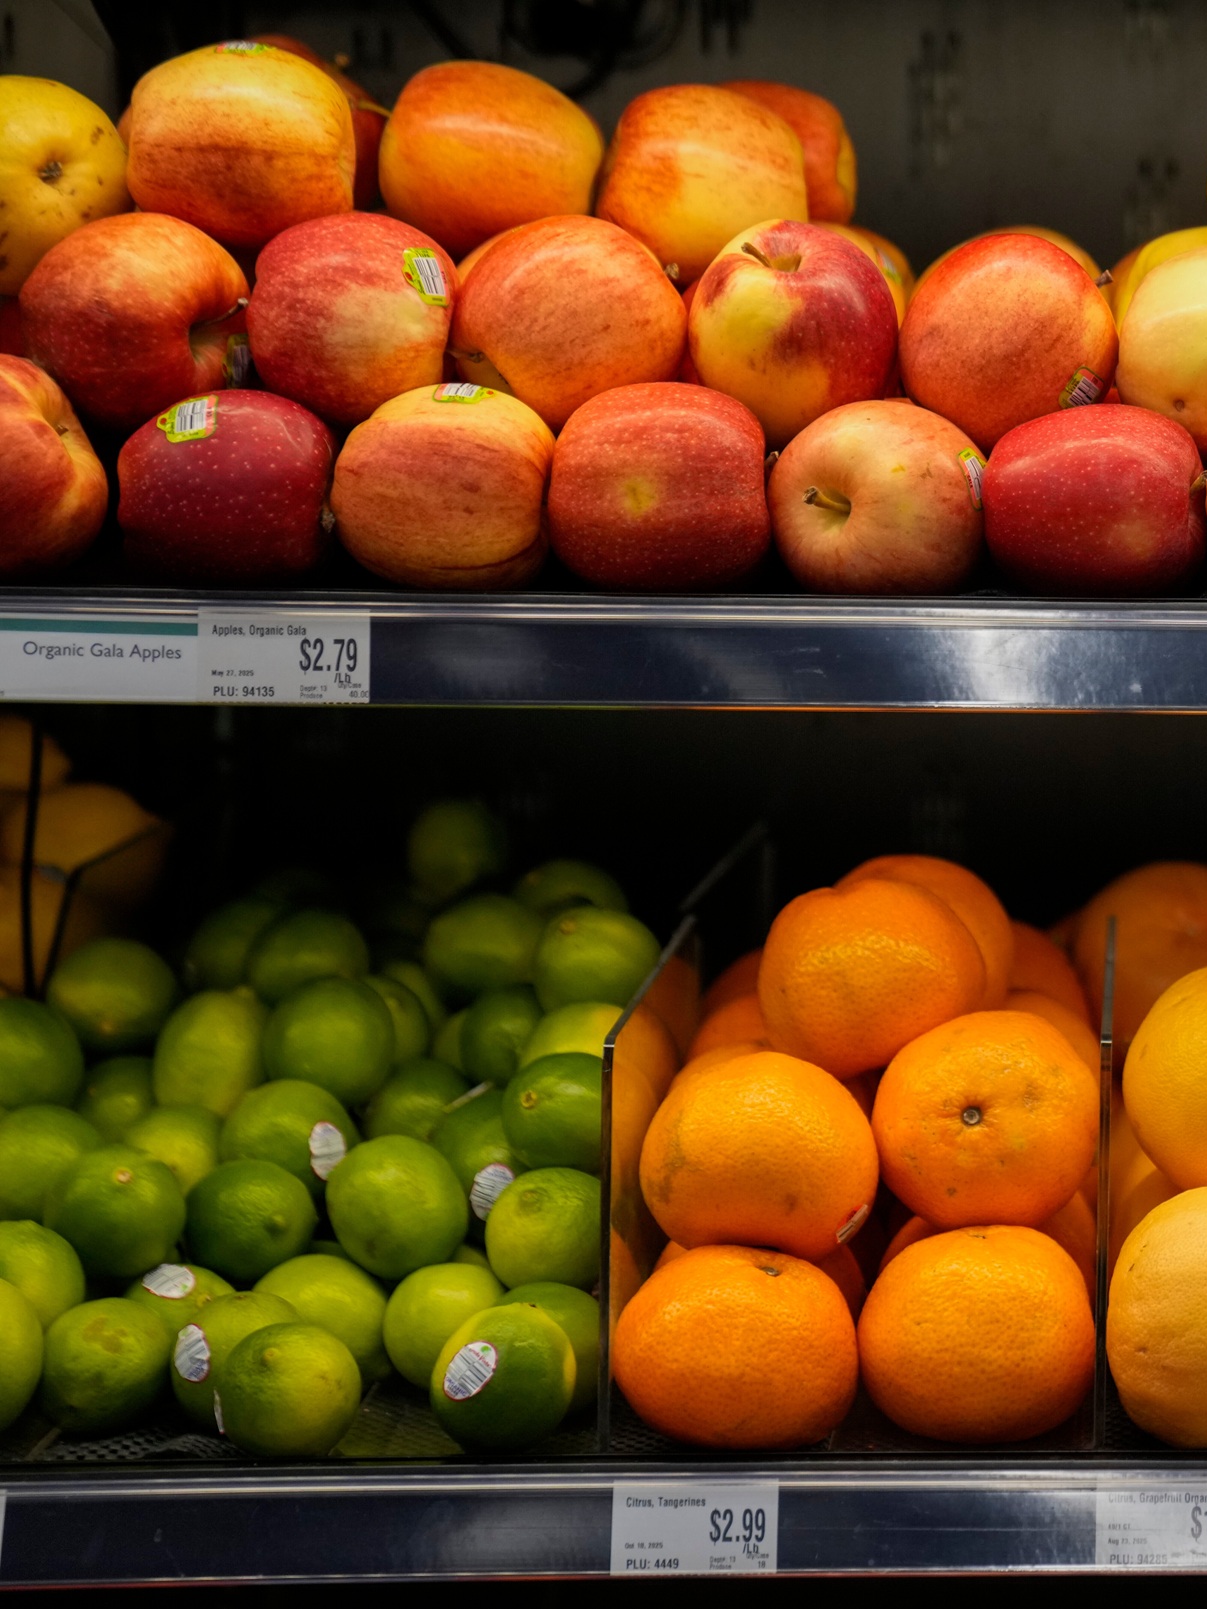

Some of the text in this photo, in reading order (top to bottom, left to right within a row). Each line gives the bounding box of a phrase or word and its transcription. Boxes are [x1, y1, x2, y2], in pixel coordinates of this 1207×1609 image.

[212, 624, 307, 638] Apples, Organic Gala
[23, 641, 182, 661] Organic Gala Apples
[300, 636, 358, 674] $2.79
[211, 669, 224, 677] May
[334, 672, 351, 684] /Lb
[213, 686, 275, 697] PLU: 94135
[626, 1497, 706, 1509] Citrus, Tangerines
[1140, 1493, 1182, 1504] Grapefruit
[709, 1508, 766, 1546] $2.99
[743, 1543, 759, 1554] /Lb
[626, 1558, 679, 1569] PLU: 4449
[1110, 1554, 1133, 1564] PLU:
